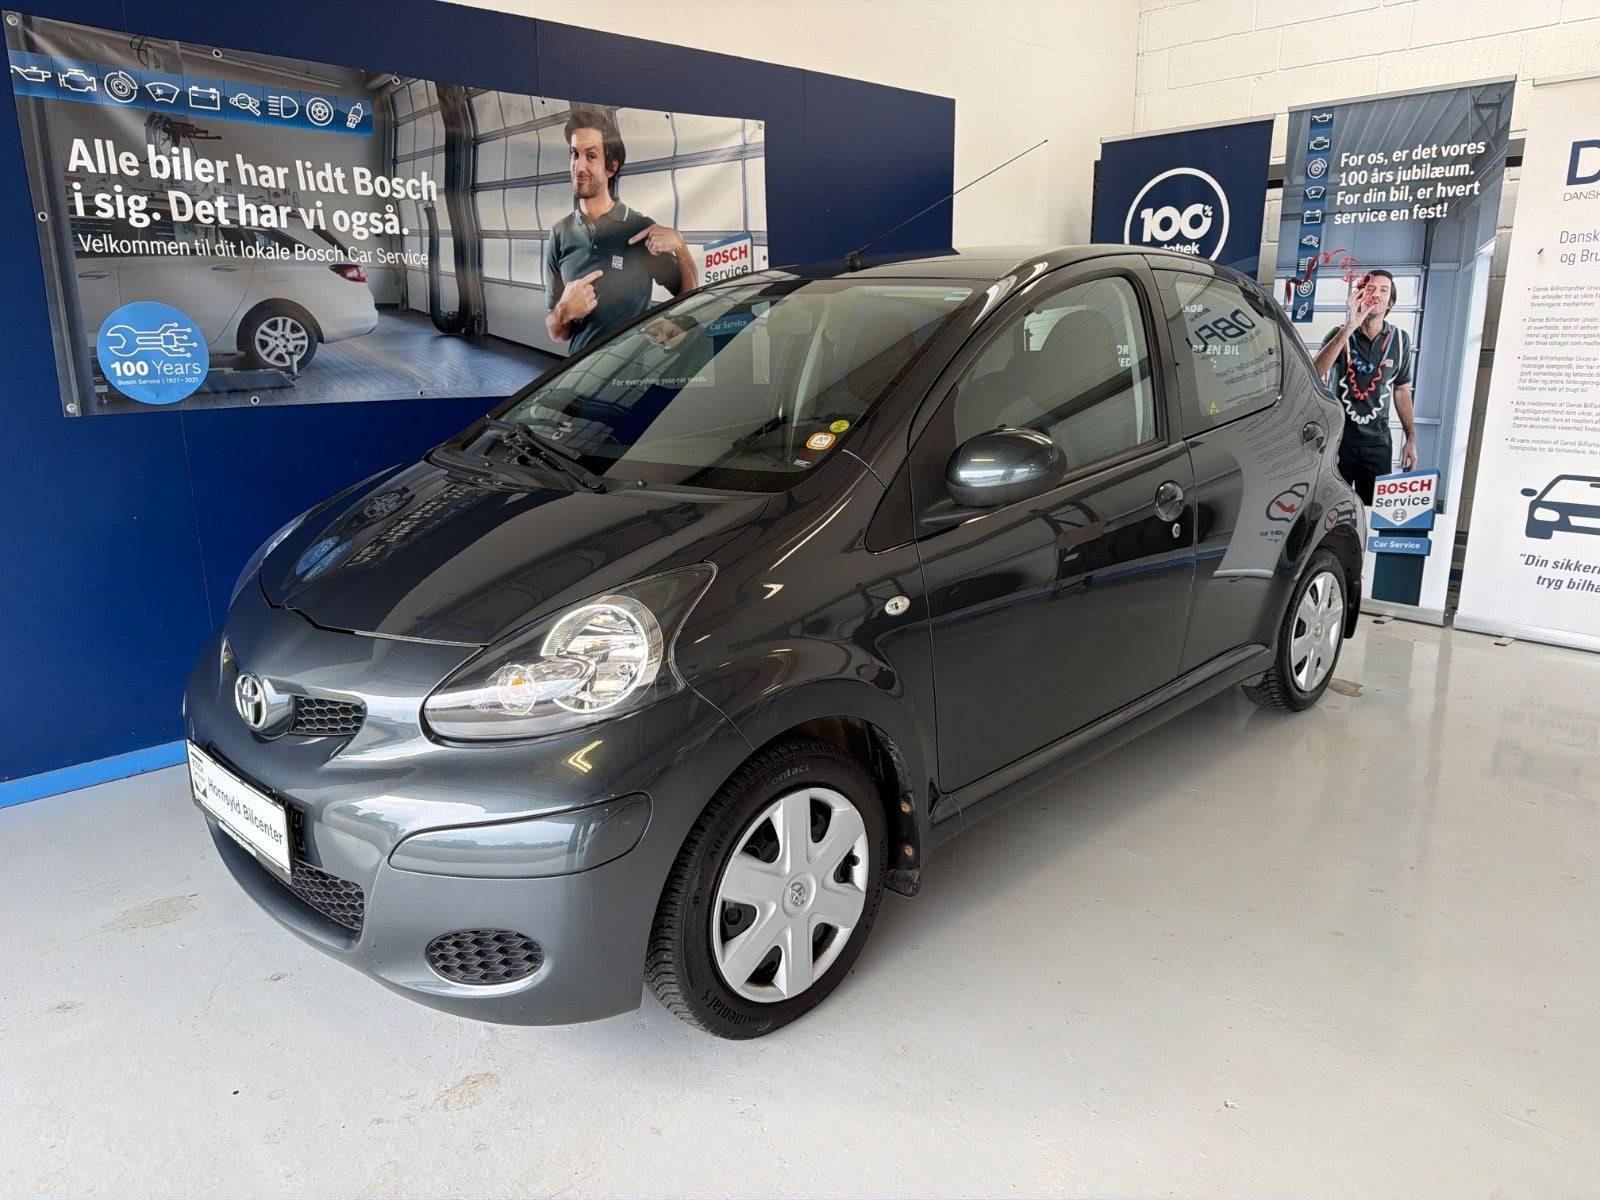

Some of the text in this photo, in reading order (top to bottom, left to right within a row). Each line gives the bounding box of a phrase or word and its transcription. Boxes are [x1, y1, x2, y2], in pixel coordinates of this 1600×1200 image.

[1340, 141, 1486, 167] For os, er det vores
[68, 138, 437, 201] Alle biler har lidt Bosch
[1339, 163, 1475, 187] 100 års jubilæum.
[1336, 180, 1481, 206] For din bil, er hvert
[72, 182, 410, 241] i sig. Det har vi også.
[1334, 202, 1449, 225] service en fest!
[1559, 229, 1600, 244] Dansk
[78, 233, 430, 266] Velkommen til dit lokale Bosch Car Service
[705, 244, 748, 269] BOSCH
[1560, 253, 1576, 266] og
[704, 264, 749, 284] Service
[710, 321, 723, 331] Car
[110, 360, 202, 377] 100 Years
[138, 378, 161, 386] Service
[612, 379, 625, 387] For
[1377, 479, 1432, 495] BOSCH
[1375, 495, 1430, 507] Service
[1390, 541, 1421, 549] Service
[1536, 575, 1564, 591] tryg
[242, 804, 283, 844] Bilcenter
